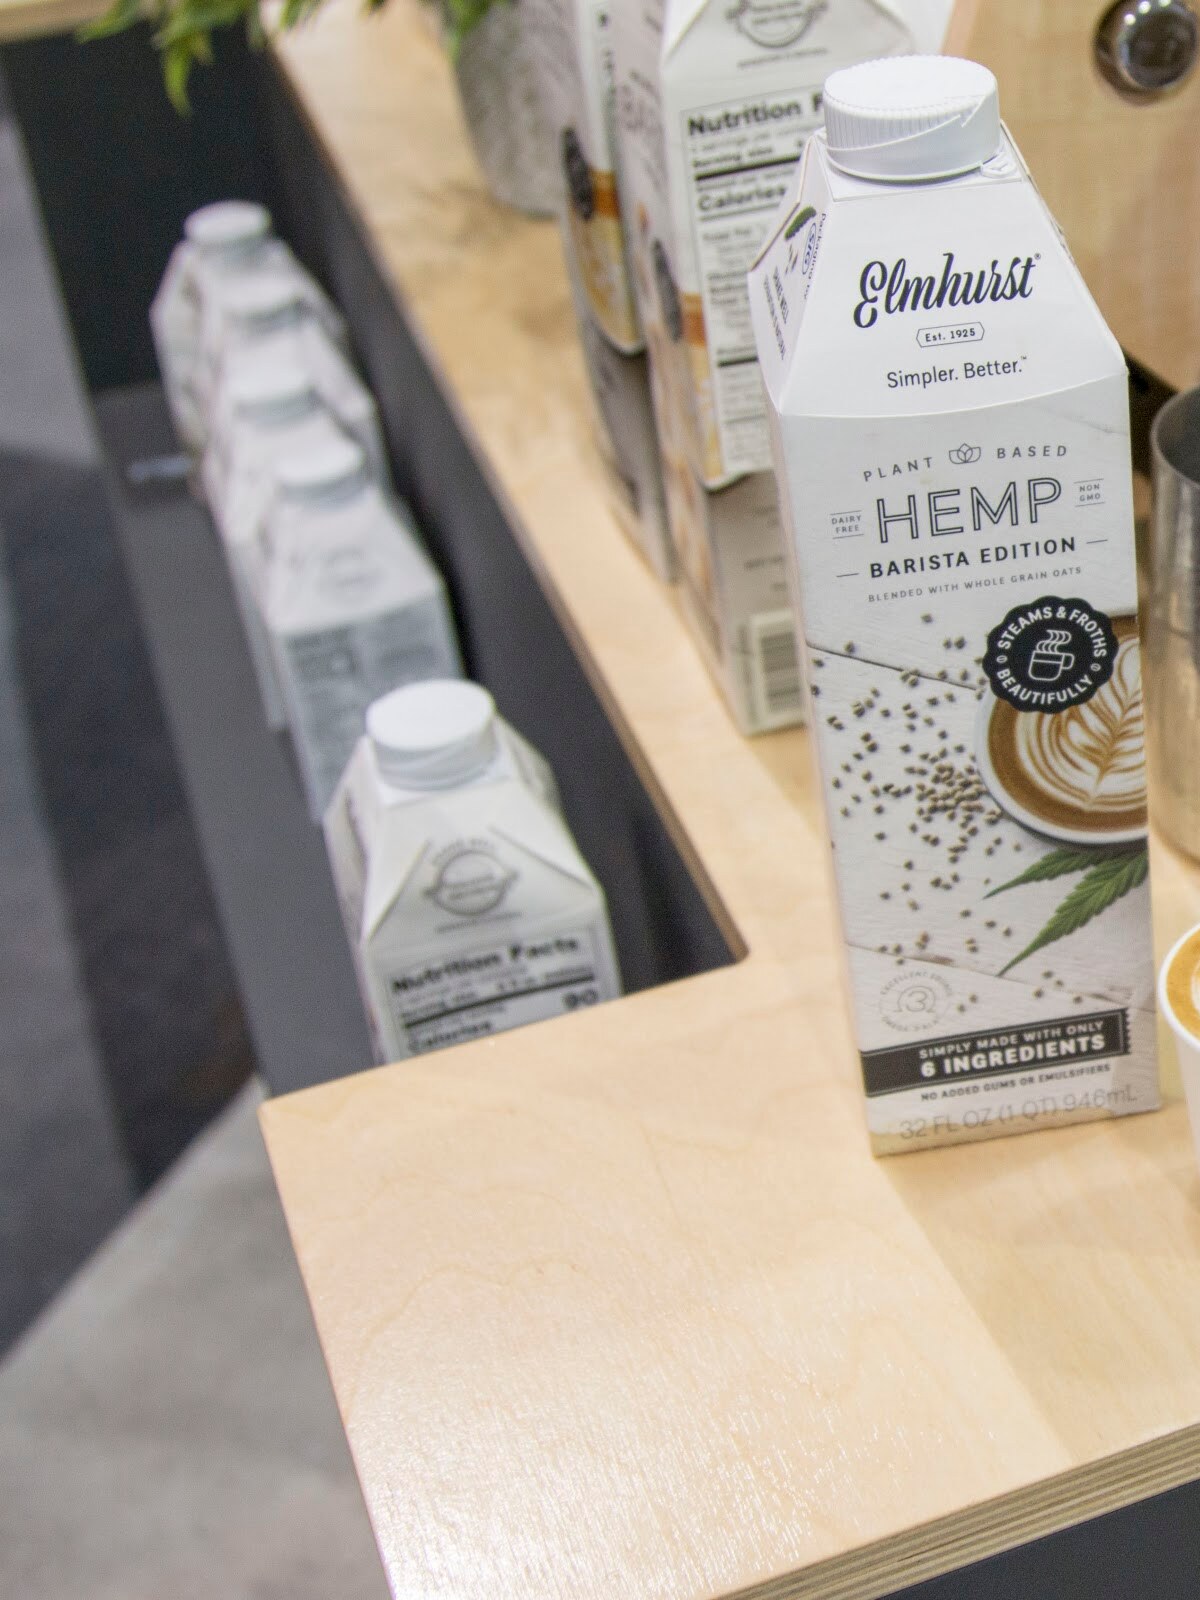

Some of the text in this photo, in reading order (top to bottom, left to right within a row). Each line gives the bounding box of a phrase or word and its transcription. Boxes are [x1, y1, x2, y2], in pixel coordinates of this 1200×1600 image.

[688, 100, 801, 135] Nutrition
[852, 252, 1036, 329] Elmhurst
[924, 328, 976, 343] Est. 1925
[886, 360, 1023, 389] Simpler. Better.
[862, 445, 1068, 483] PLANT BASED
[1078, 483, 1101, 493] NON
[1079, 492, 1101, 503] GMO
[831, 514, 862, 526] DAIRY
[876, 476, 1062, 544] HEMP
[835, 524, 861, 535] FREE
[869, 536, 1076, 579] BARISTA EDITION
[868, 566, 1083, 603] BLENDED WITH WHOLE GRAIN OATS
[997, 605, 1108, 659] STEAMS & FROTHS
[996, 673, 1093, 706] BEAUTIFULLY
[918, 1020, 1104, 1060] SIMPLY MADE WITH ONLY
[920, 1033, 1106, 1079] 6 INGREDIENTS
[920, 1063, 1111, 1102] NO ADDED GUMS OR EMULSIFIERS
[900, 1117, 928, 1140] 32
[932, 1112, 959, 1133] FL
[962, 1108, 993, 1129] OZ
